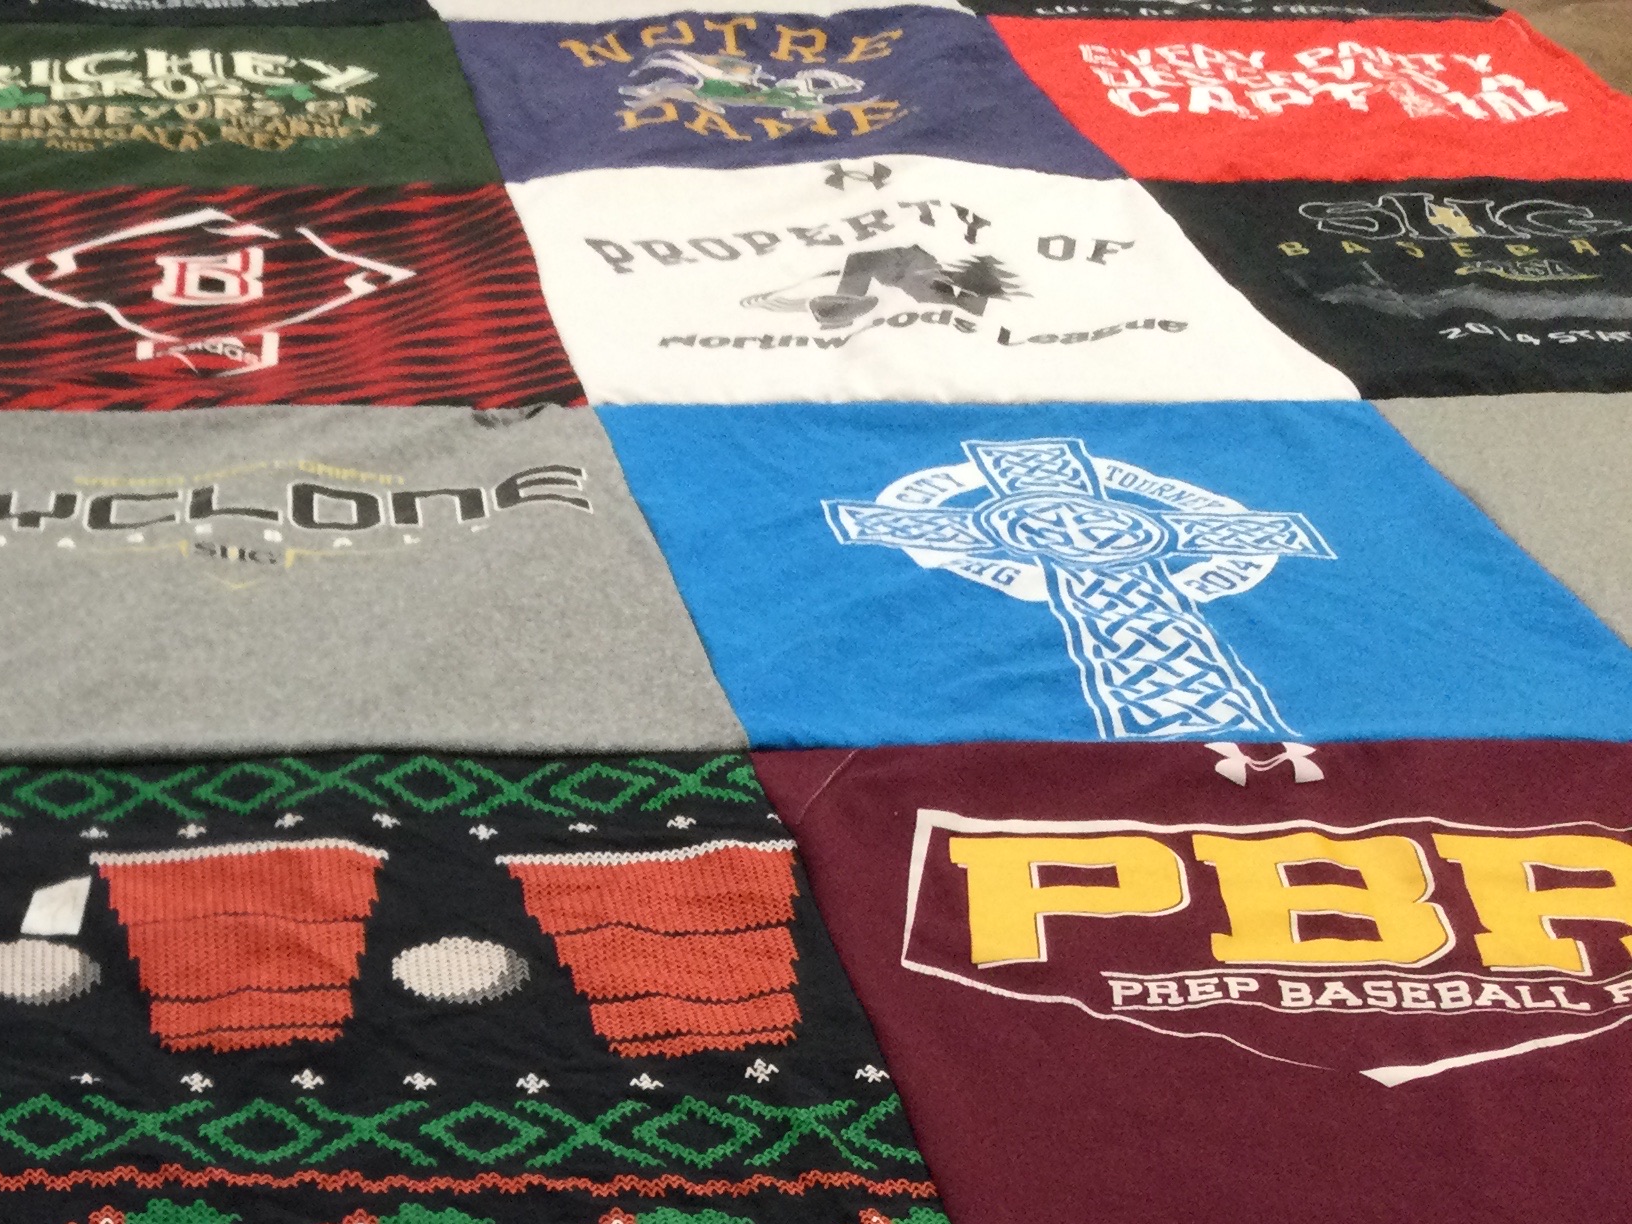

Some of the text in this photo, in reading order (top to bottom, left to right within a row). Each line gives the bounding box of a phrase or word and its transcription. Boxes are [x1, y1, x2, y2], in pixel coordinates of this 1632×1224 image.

[560, 17, 904, 68] NOTRE
[1077, 43, 1266, 70] EVERY
[304, 96, 378, 120] OF
[614, 99, 904, 141] DAME
[585, 199, 1136, 274] PROPERTY OF
[997, 317, 1188, 347] League
[895, 462, 1228, 515] CITY TOURNEY
[1184, 556, 1264, 596] 2014
[949, 832, 1632, 975] PBR
[1109, 973, 1260, 1008] PREP
[1278, 978, 1592, 1012] BASEBALL
